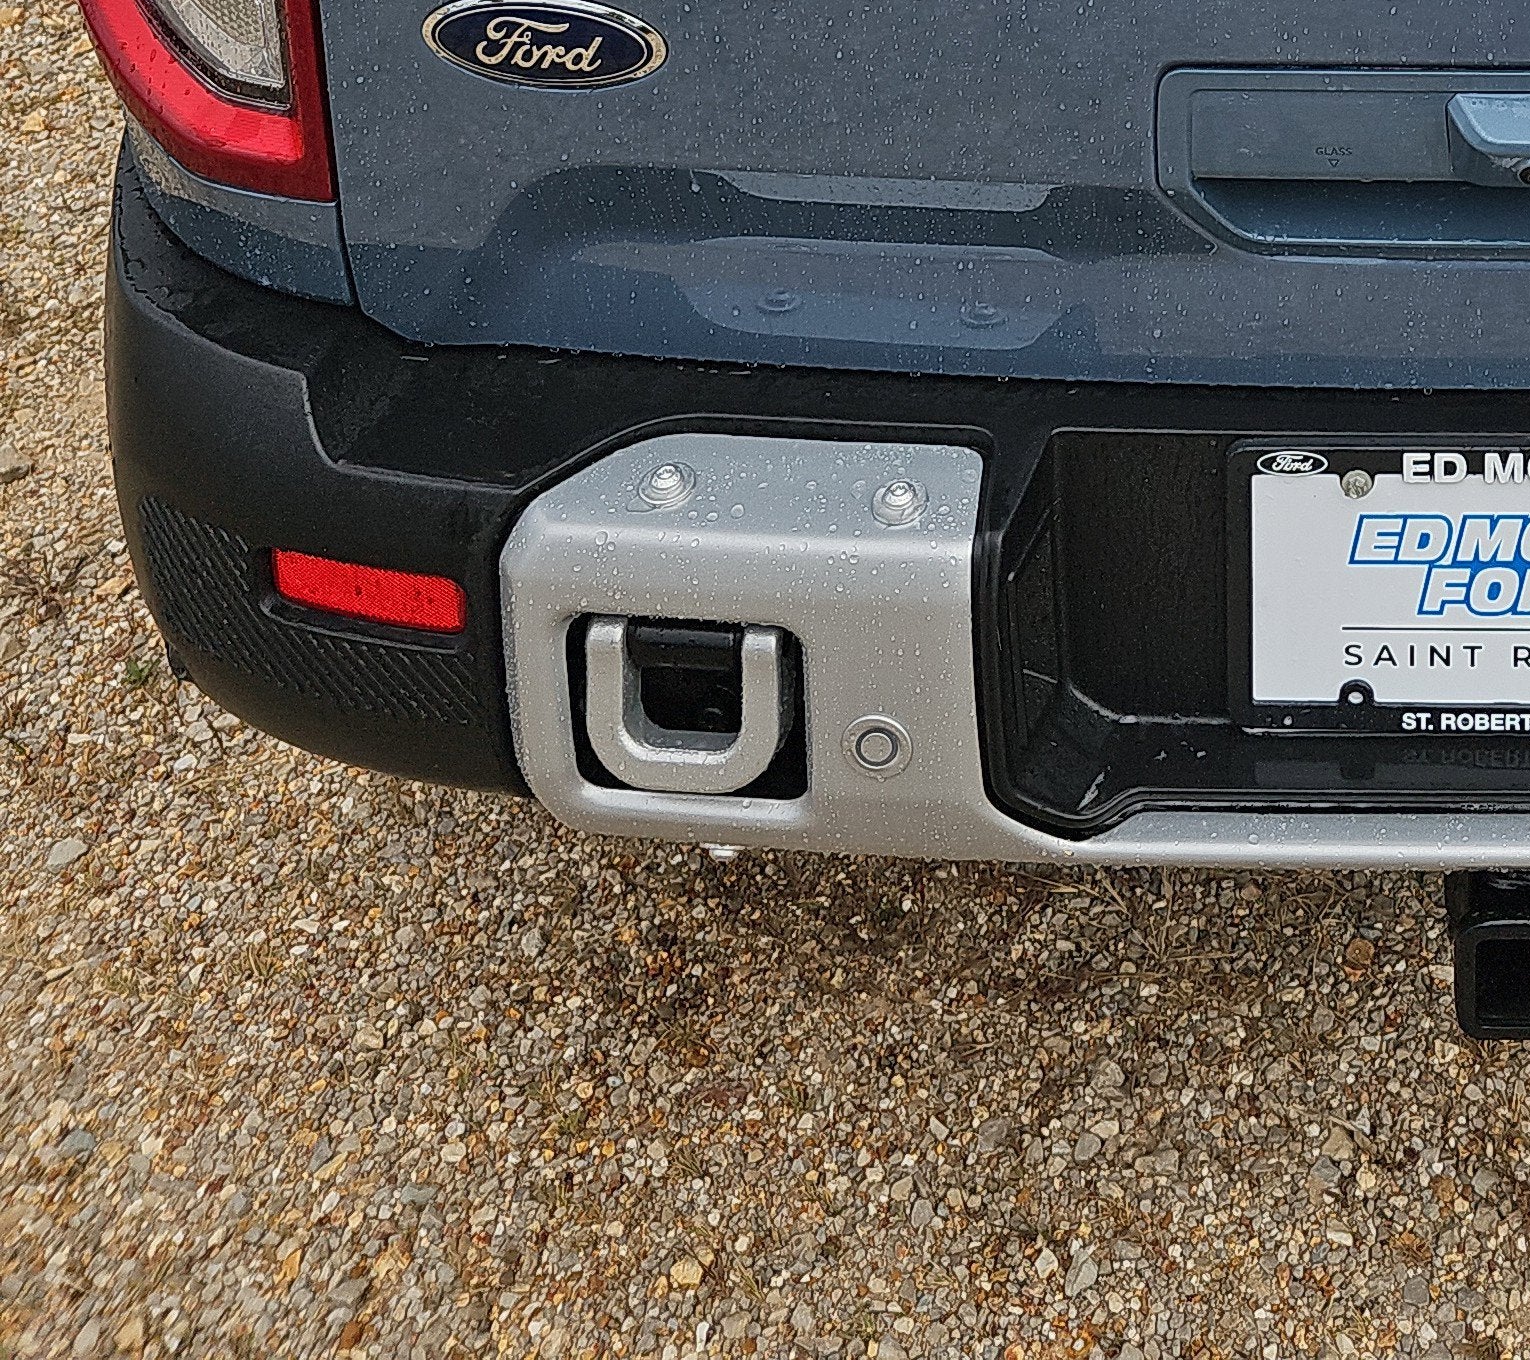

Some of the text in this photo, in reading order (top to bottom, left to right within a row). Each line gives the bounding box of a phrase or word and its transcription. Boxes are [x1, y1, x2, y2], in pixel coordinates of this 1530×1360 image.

[475, 16, 603, 72] Ford
[1314, 146, 1353, 157] GLASS
[1271, 454, 1314, 472] Ford
[1402, 452, 1470, 483] ED
[1348, 514, 1454, 565] ED
[1344, 644, 1483, 667] SAINT
[1402, 713, 1434, 731] ST.
